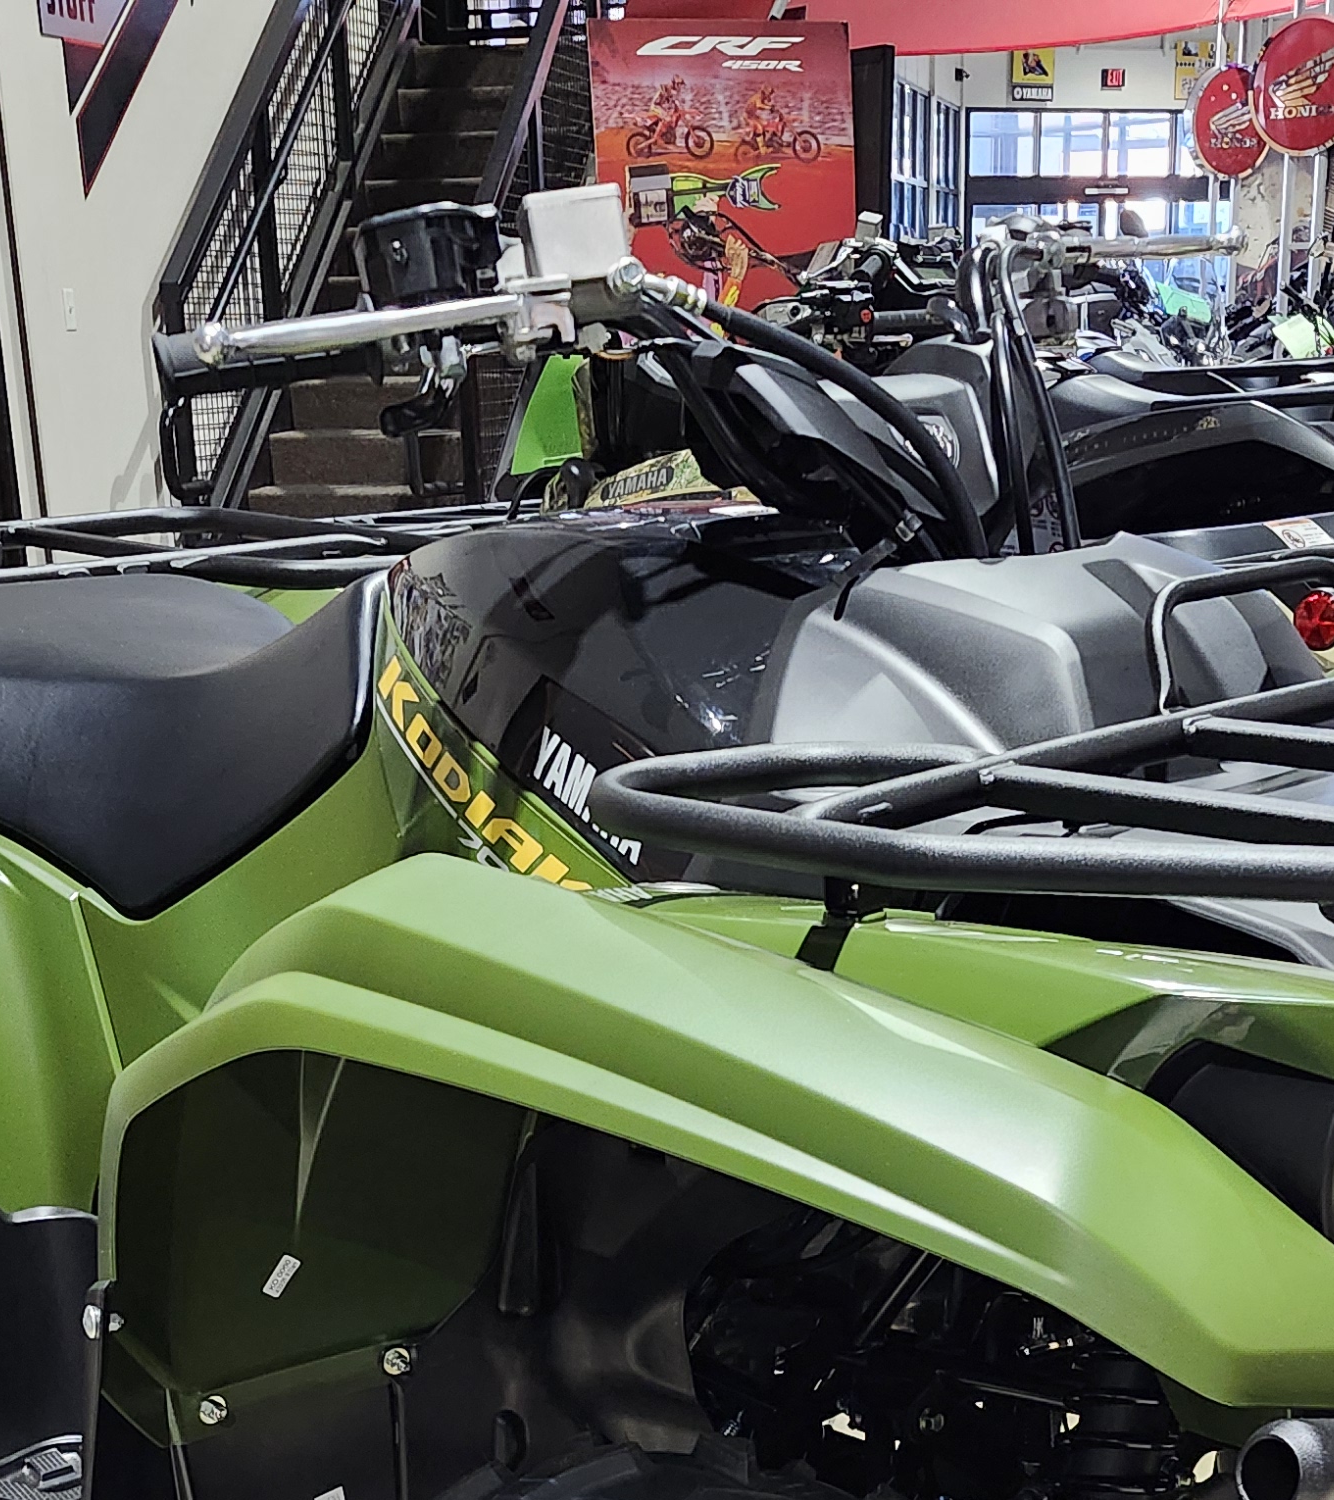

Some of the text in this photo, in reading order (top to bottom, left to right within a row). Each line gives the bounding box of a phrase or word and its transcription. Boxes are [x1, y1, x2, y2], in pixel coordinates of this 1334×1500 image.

[636, 36, 806, 56] CRF
[721, 60, 805, 72] 450R
[1022, 88, 1053, 100] YAMAHA
[608, 467, 668, 498] YAMAHA
[533, 726, 643, 866] YAM
[457, 818, 510, 873] 70
